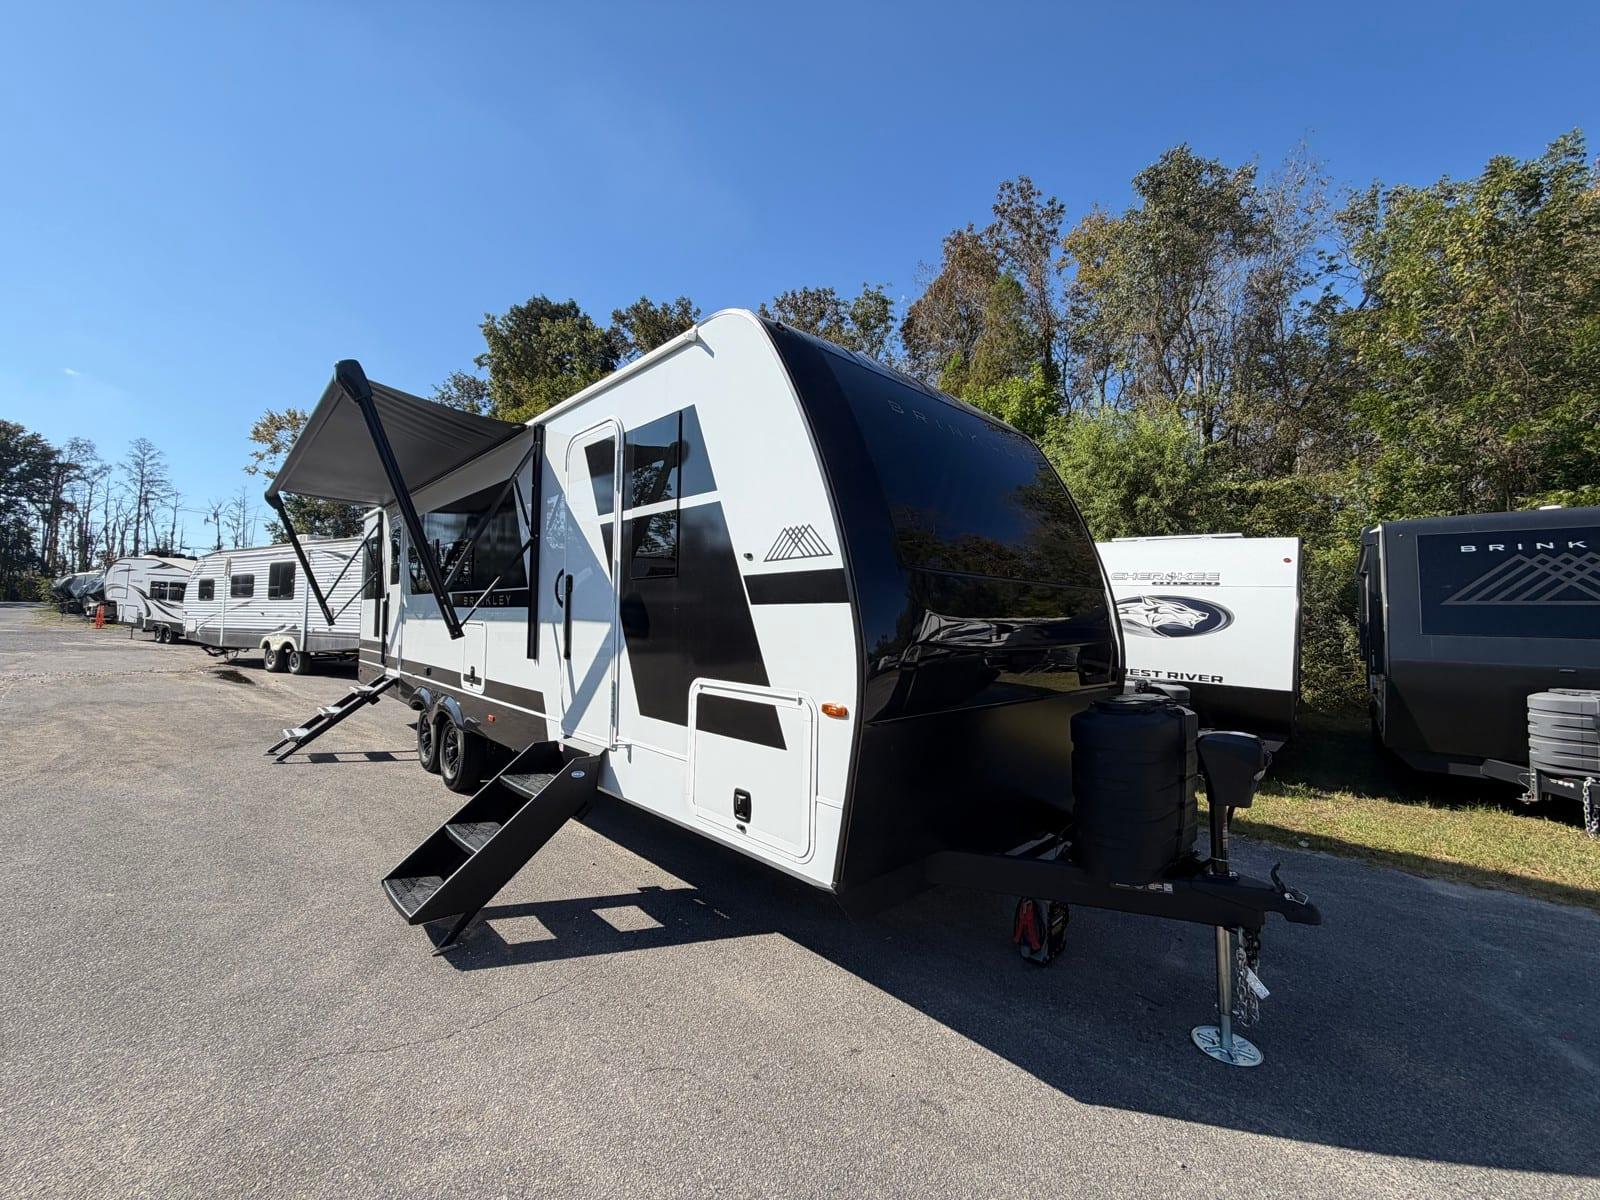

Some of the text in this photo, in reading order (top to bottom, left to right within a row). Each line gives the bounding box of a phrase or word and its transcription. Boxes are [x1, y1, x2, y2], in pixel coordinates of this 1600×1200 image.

[1460, 541, 1588, 552] BRINK
[463, 595, 511, 606] BRIKLEY
[1126, 668, 1224, 684] EST RIVER
